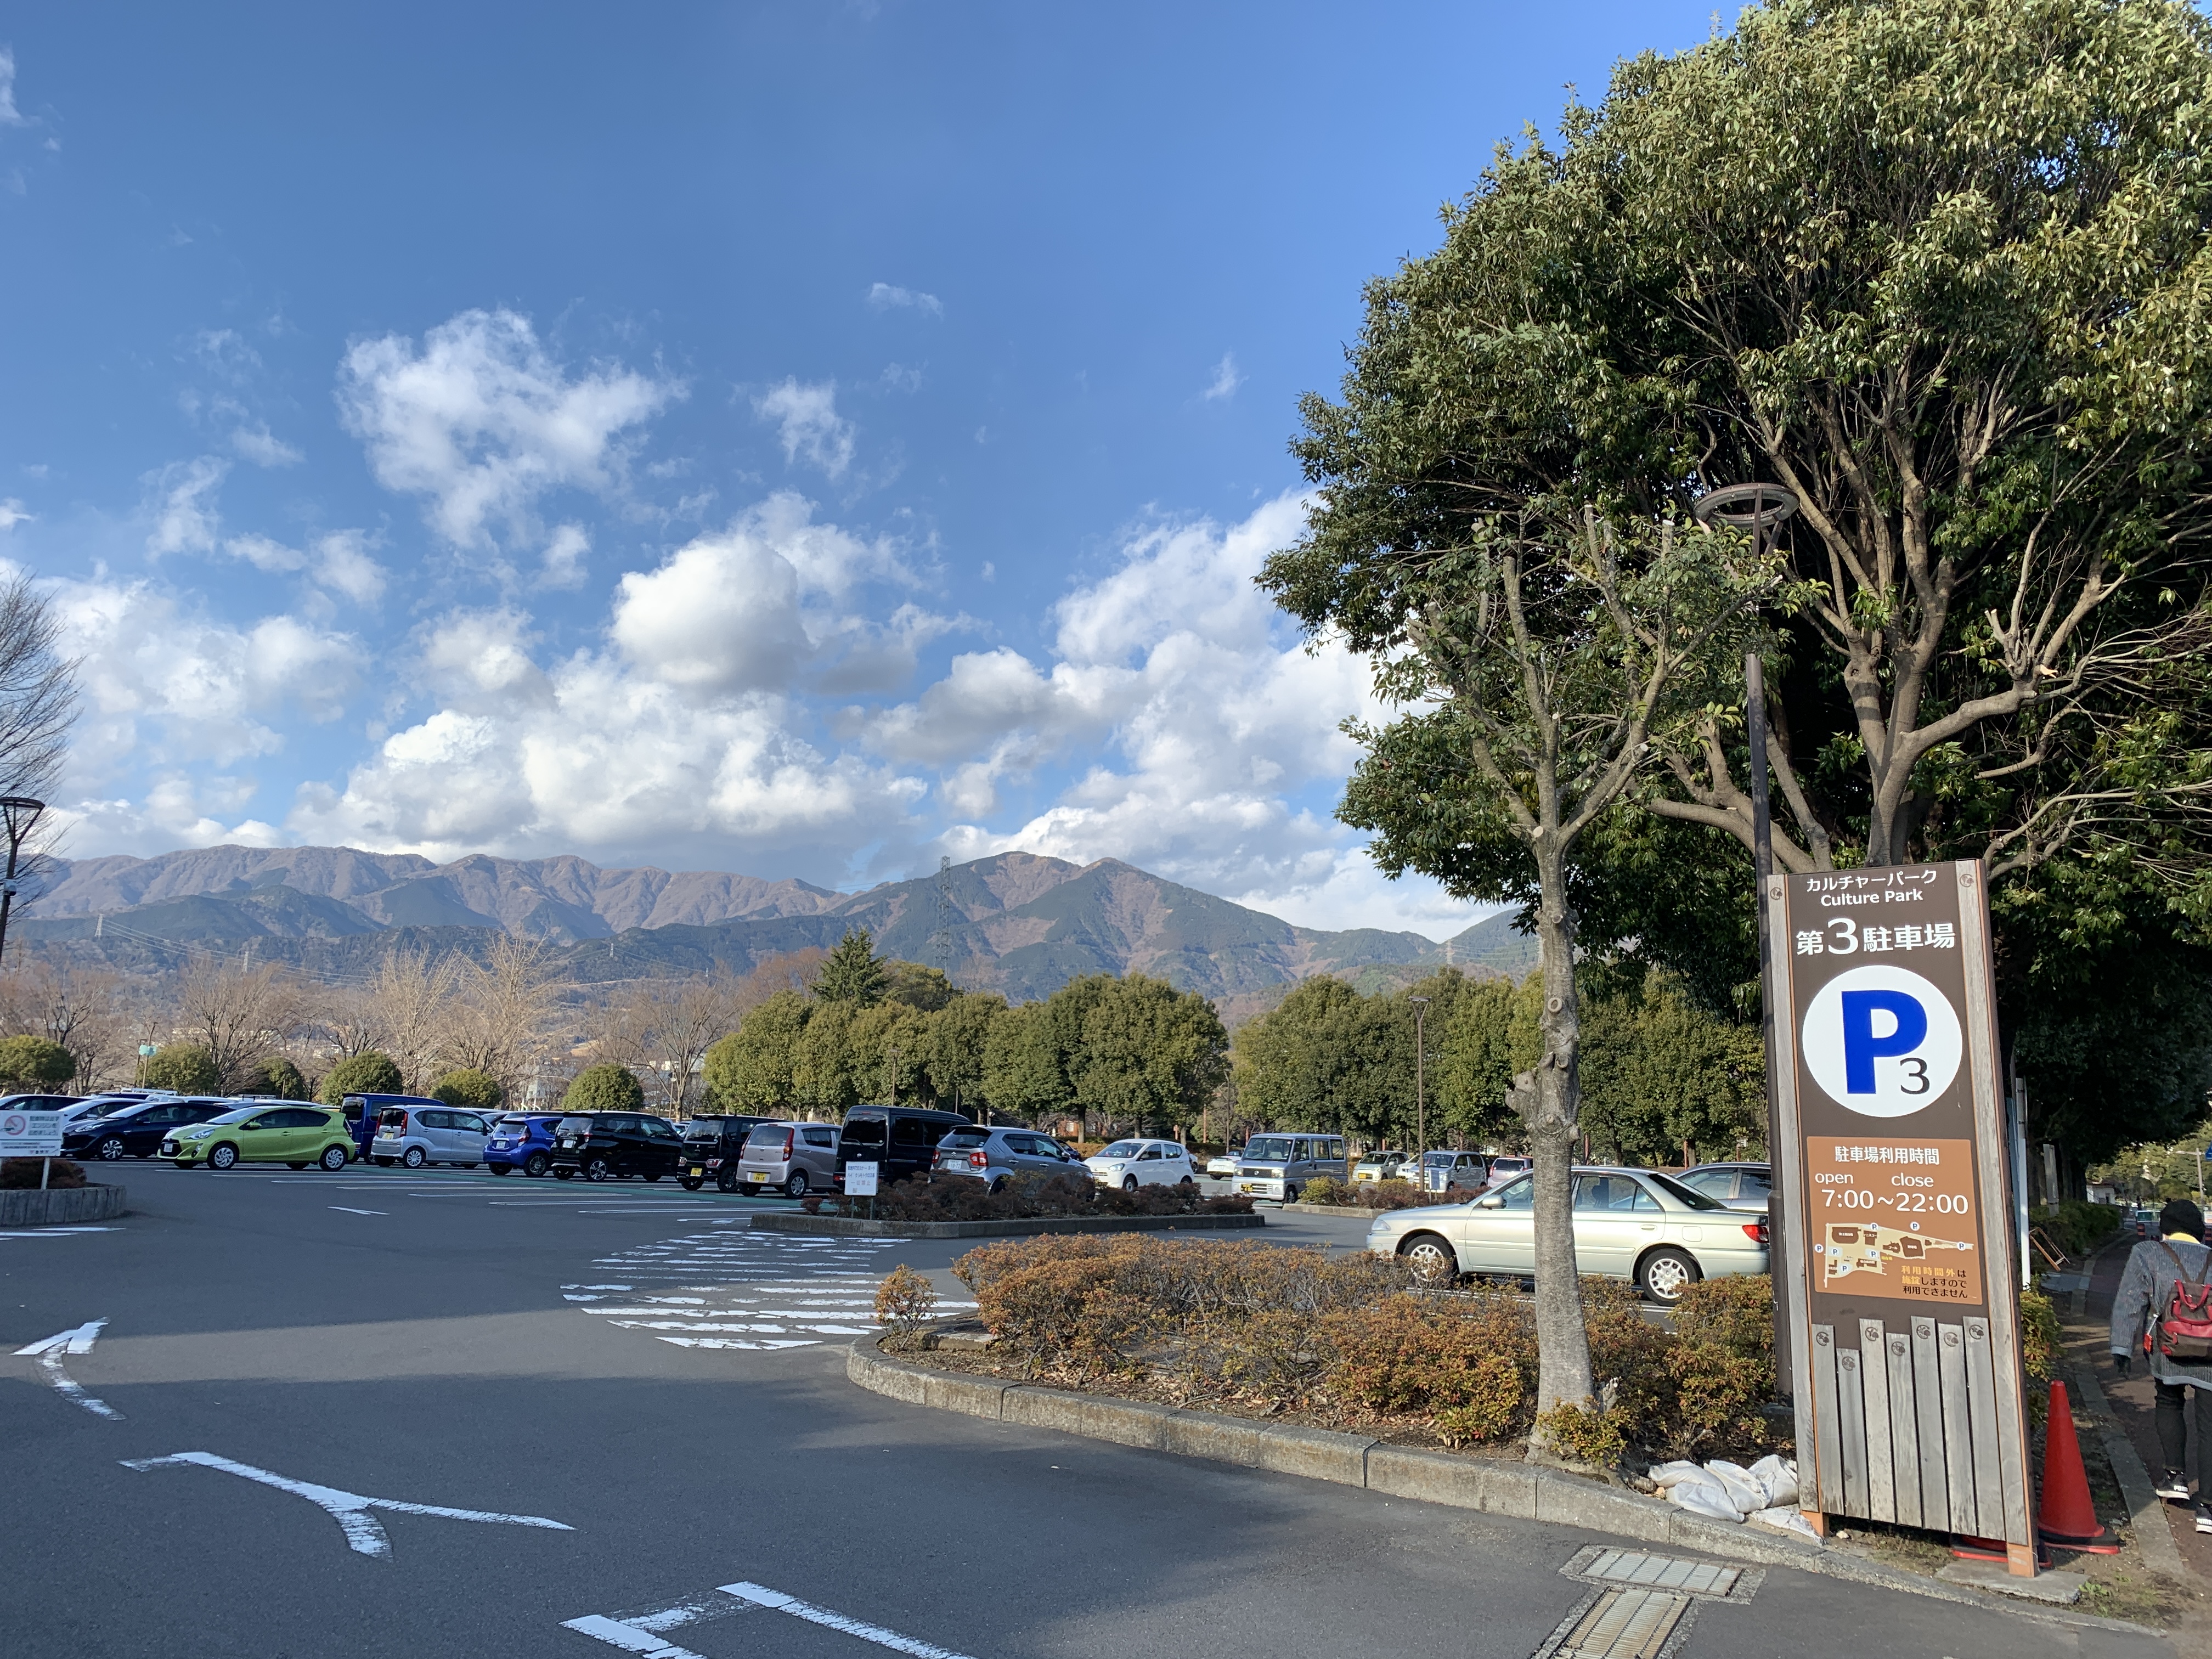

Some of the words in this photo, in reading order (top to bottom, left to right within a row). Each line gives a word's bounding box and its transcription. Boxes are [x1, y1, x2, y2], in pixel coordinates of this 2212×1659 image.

[1806, 870, 1937, 893] カルチャーパーク
[1820, 891, 1880, 906] Culture
[1884, 888, 1923, 903] Park
[1796, 918, 1956, 956] 第3駐車場
[1835, 1145, 1940, 1165] 駐車場利用時間
[1815, 1172, 1854, 1185] open
[1891, 1172, 1934, 1187] close
[1901, 1265, 1967, 1278] 利用時間外は
[1901, 1275, 1967, 1288] 施錠しますので
[1903, 1285, 1968, 1298] 利用できません
